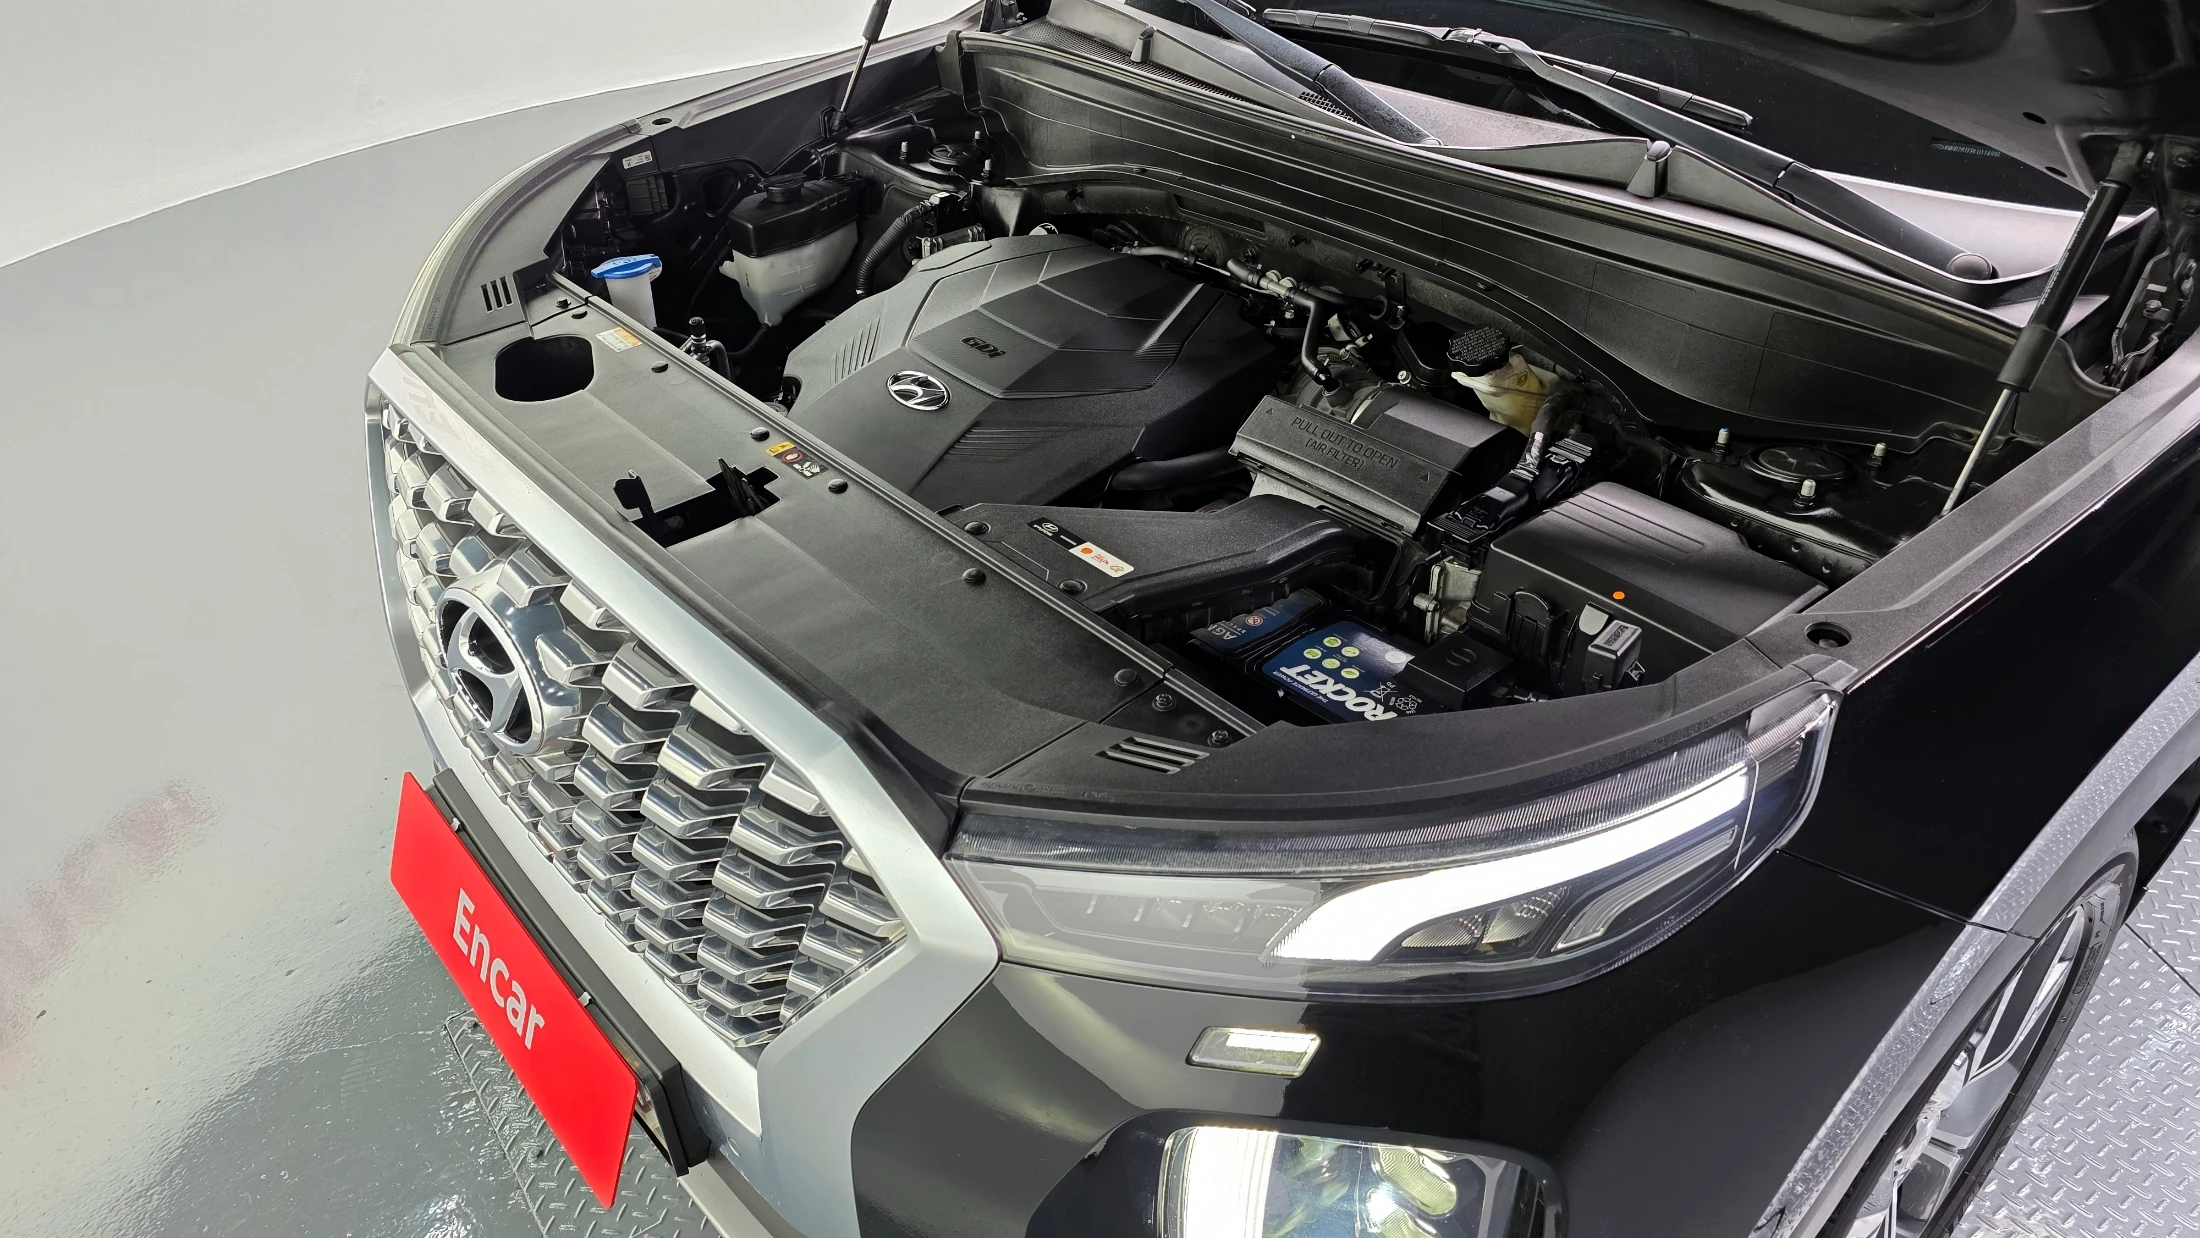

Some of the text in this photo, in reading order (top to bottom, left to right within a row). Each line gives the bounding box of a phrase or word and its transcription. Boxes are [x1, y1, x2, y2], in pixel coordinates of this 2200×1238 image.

[961, 336, 1007, 358] GDi
[1291, 416, 1400, 469] PULL OUT TO OPEN
[1279, 664, 1398, 721] ROCKET
[452, 887, 545, 1051] Encar
